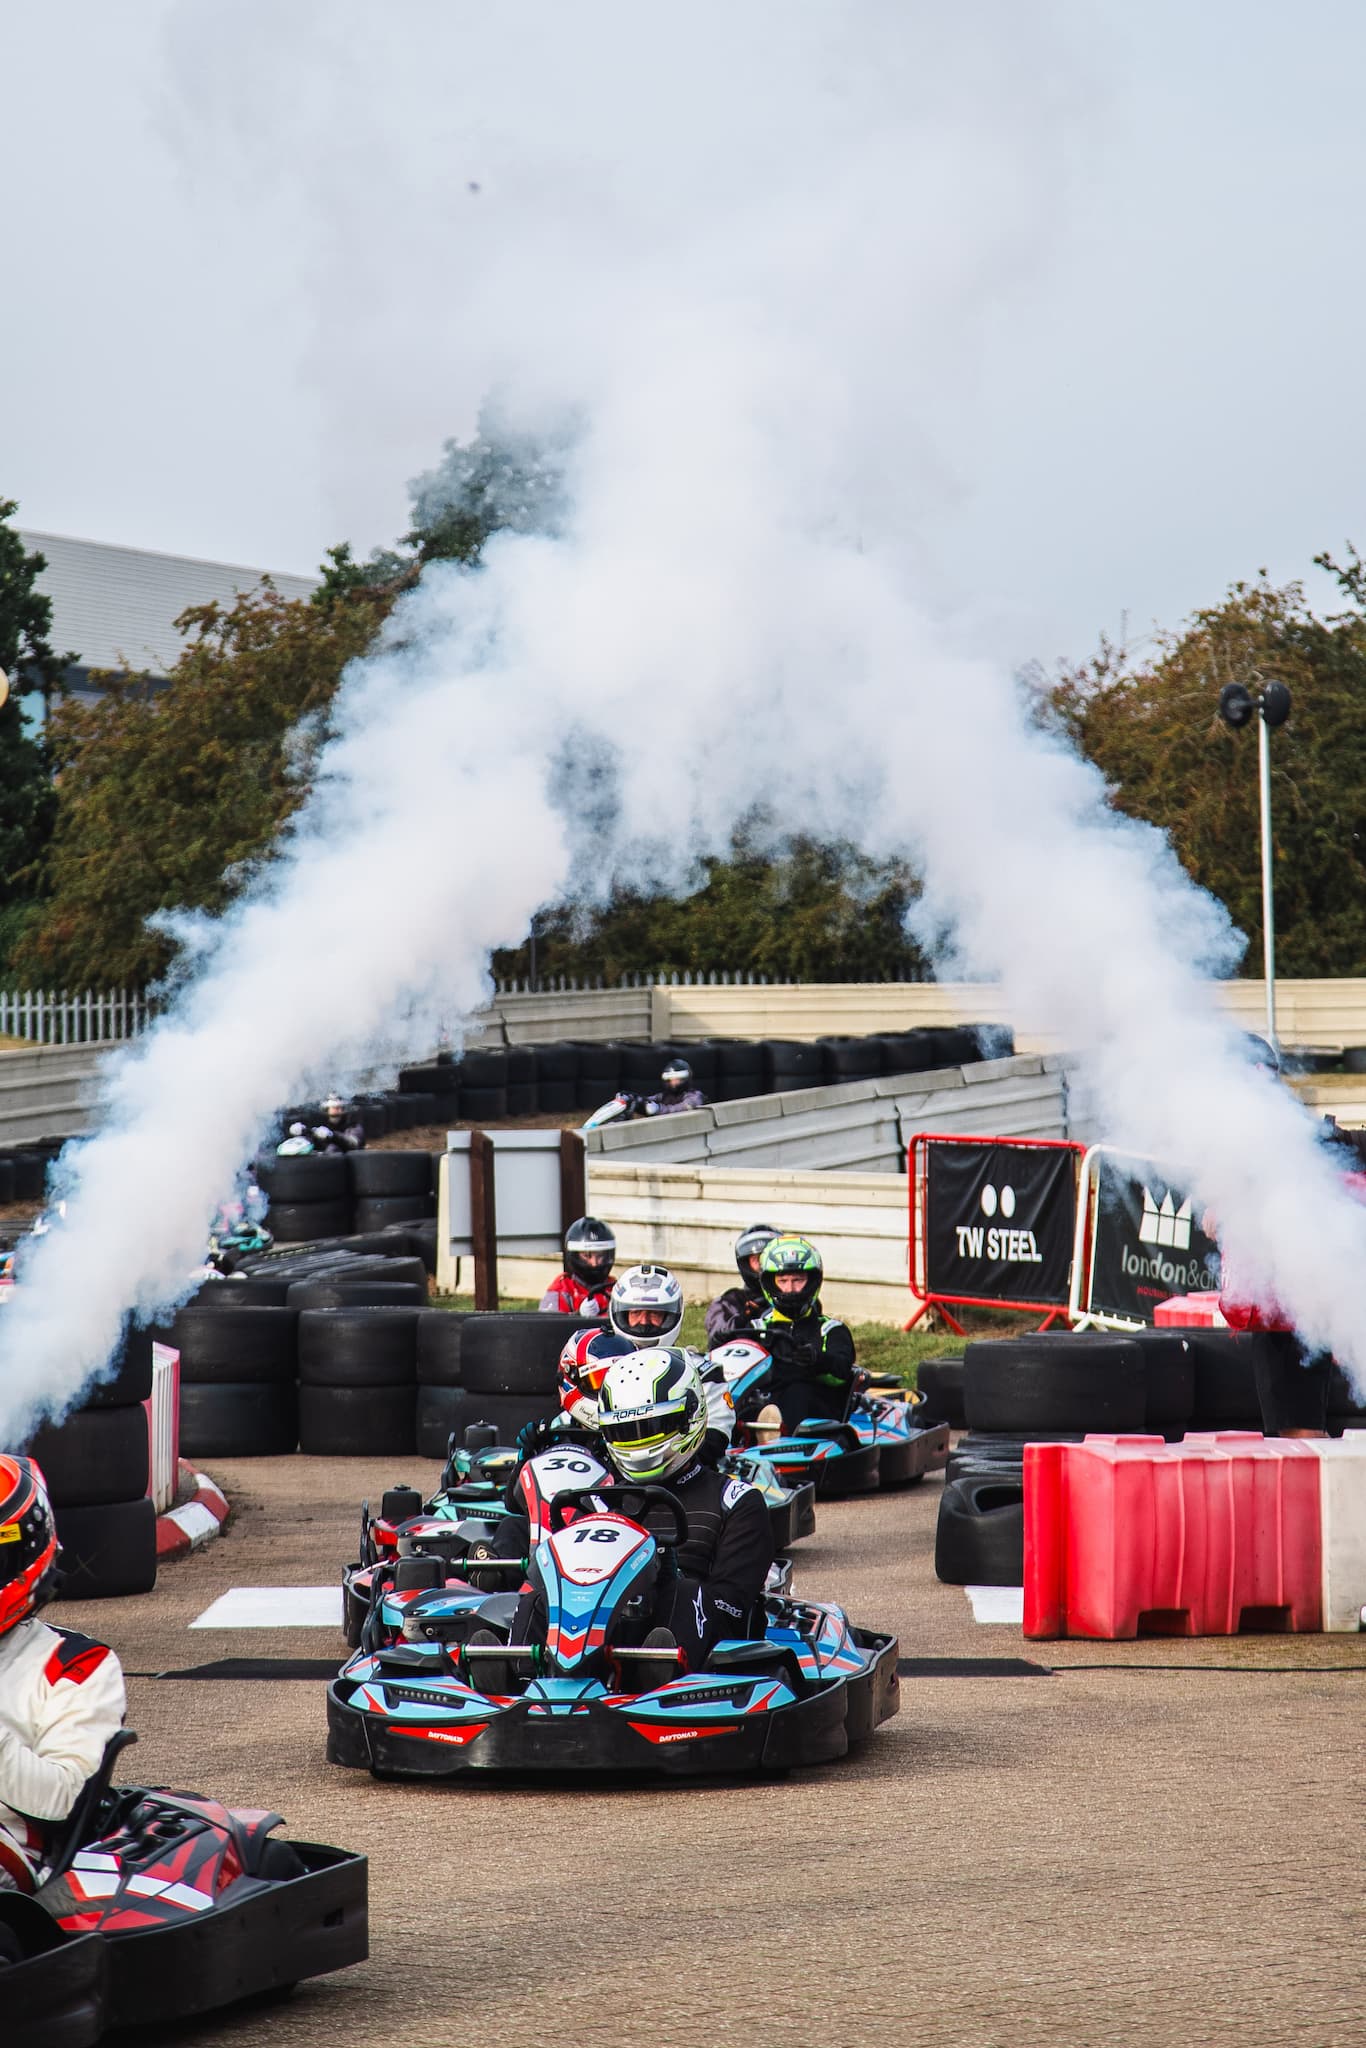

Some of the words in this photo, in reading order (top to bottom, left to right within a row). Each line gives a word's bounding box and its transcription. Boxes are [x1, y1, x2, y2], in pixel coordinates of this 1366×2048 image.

[956, 1226, 984, 1258] TW
[987, 1227, 1042, 1262] STEEL
[723, 1348, 751, 1357] 19
[542, 1458, 591, 1473] 30
[574, 1529, 620, 1543] 18
